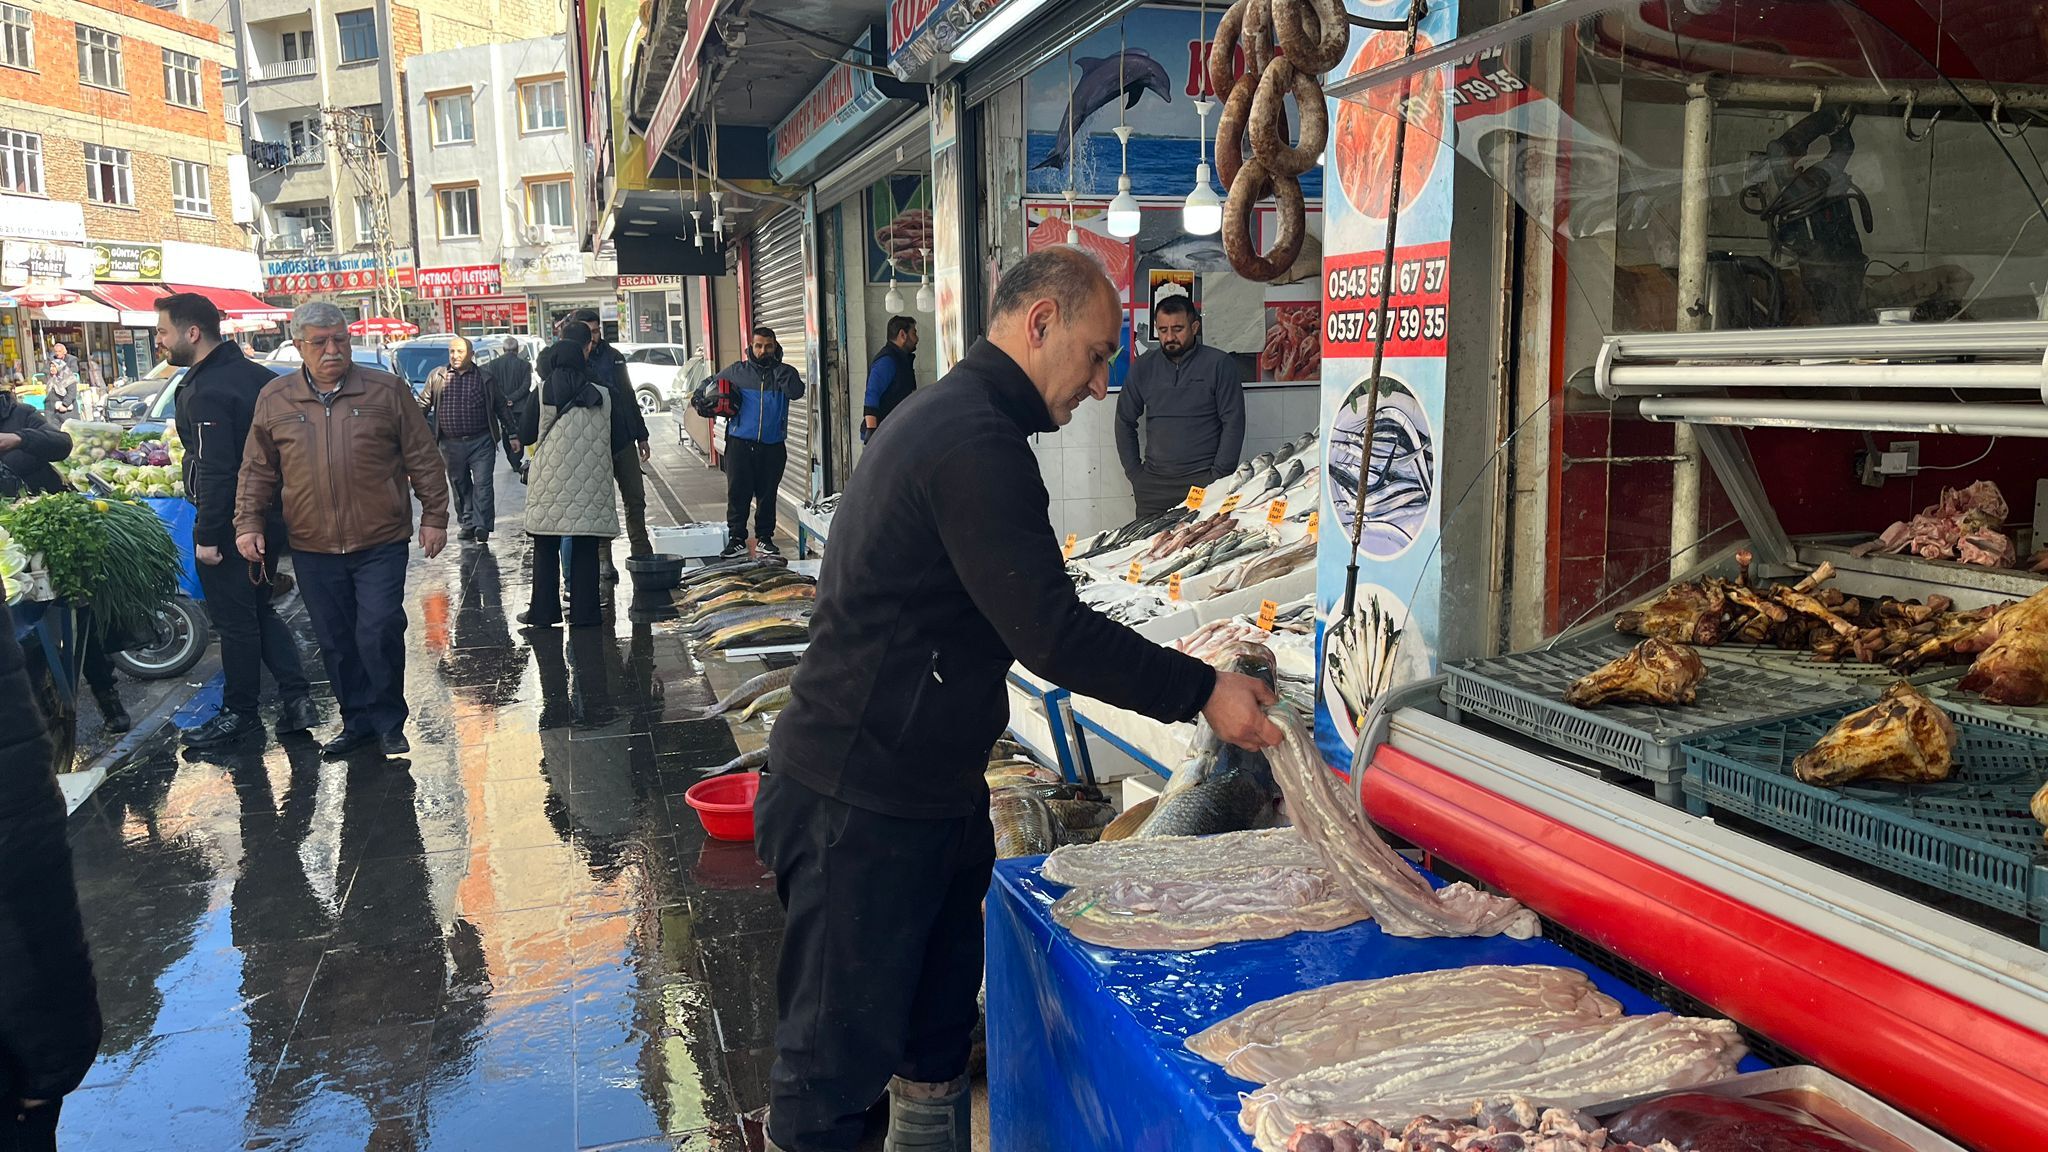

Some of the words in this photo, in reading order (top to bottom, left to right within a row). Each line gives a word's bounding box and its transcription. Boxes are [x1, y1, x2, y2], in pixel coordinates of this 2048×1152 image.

[31, 260, 64, 273] TİCARET
[111, 260, 139, 271] TİCARET
[420, 272, 453, 285] PETROL
[462, 266, 500, 286] İLETİŞİM
[620, 276, 654, 286] ERCAN
[1328, 267, 1367, 299] 0543
[1369, 264, 1396, 296] 51
[1400, 262, 1421, 293] 67
[1424, 259, 1446, 291] 37
[1327, 311, 1365, 341] 0537
[1367, 310, 1396, 339] 27
[1399, 308, 1420, 339] 39
[1423, 307, 1445, 338] 35
